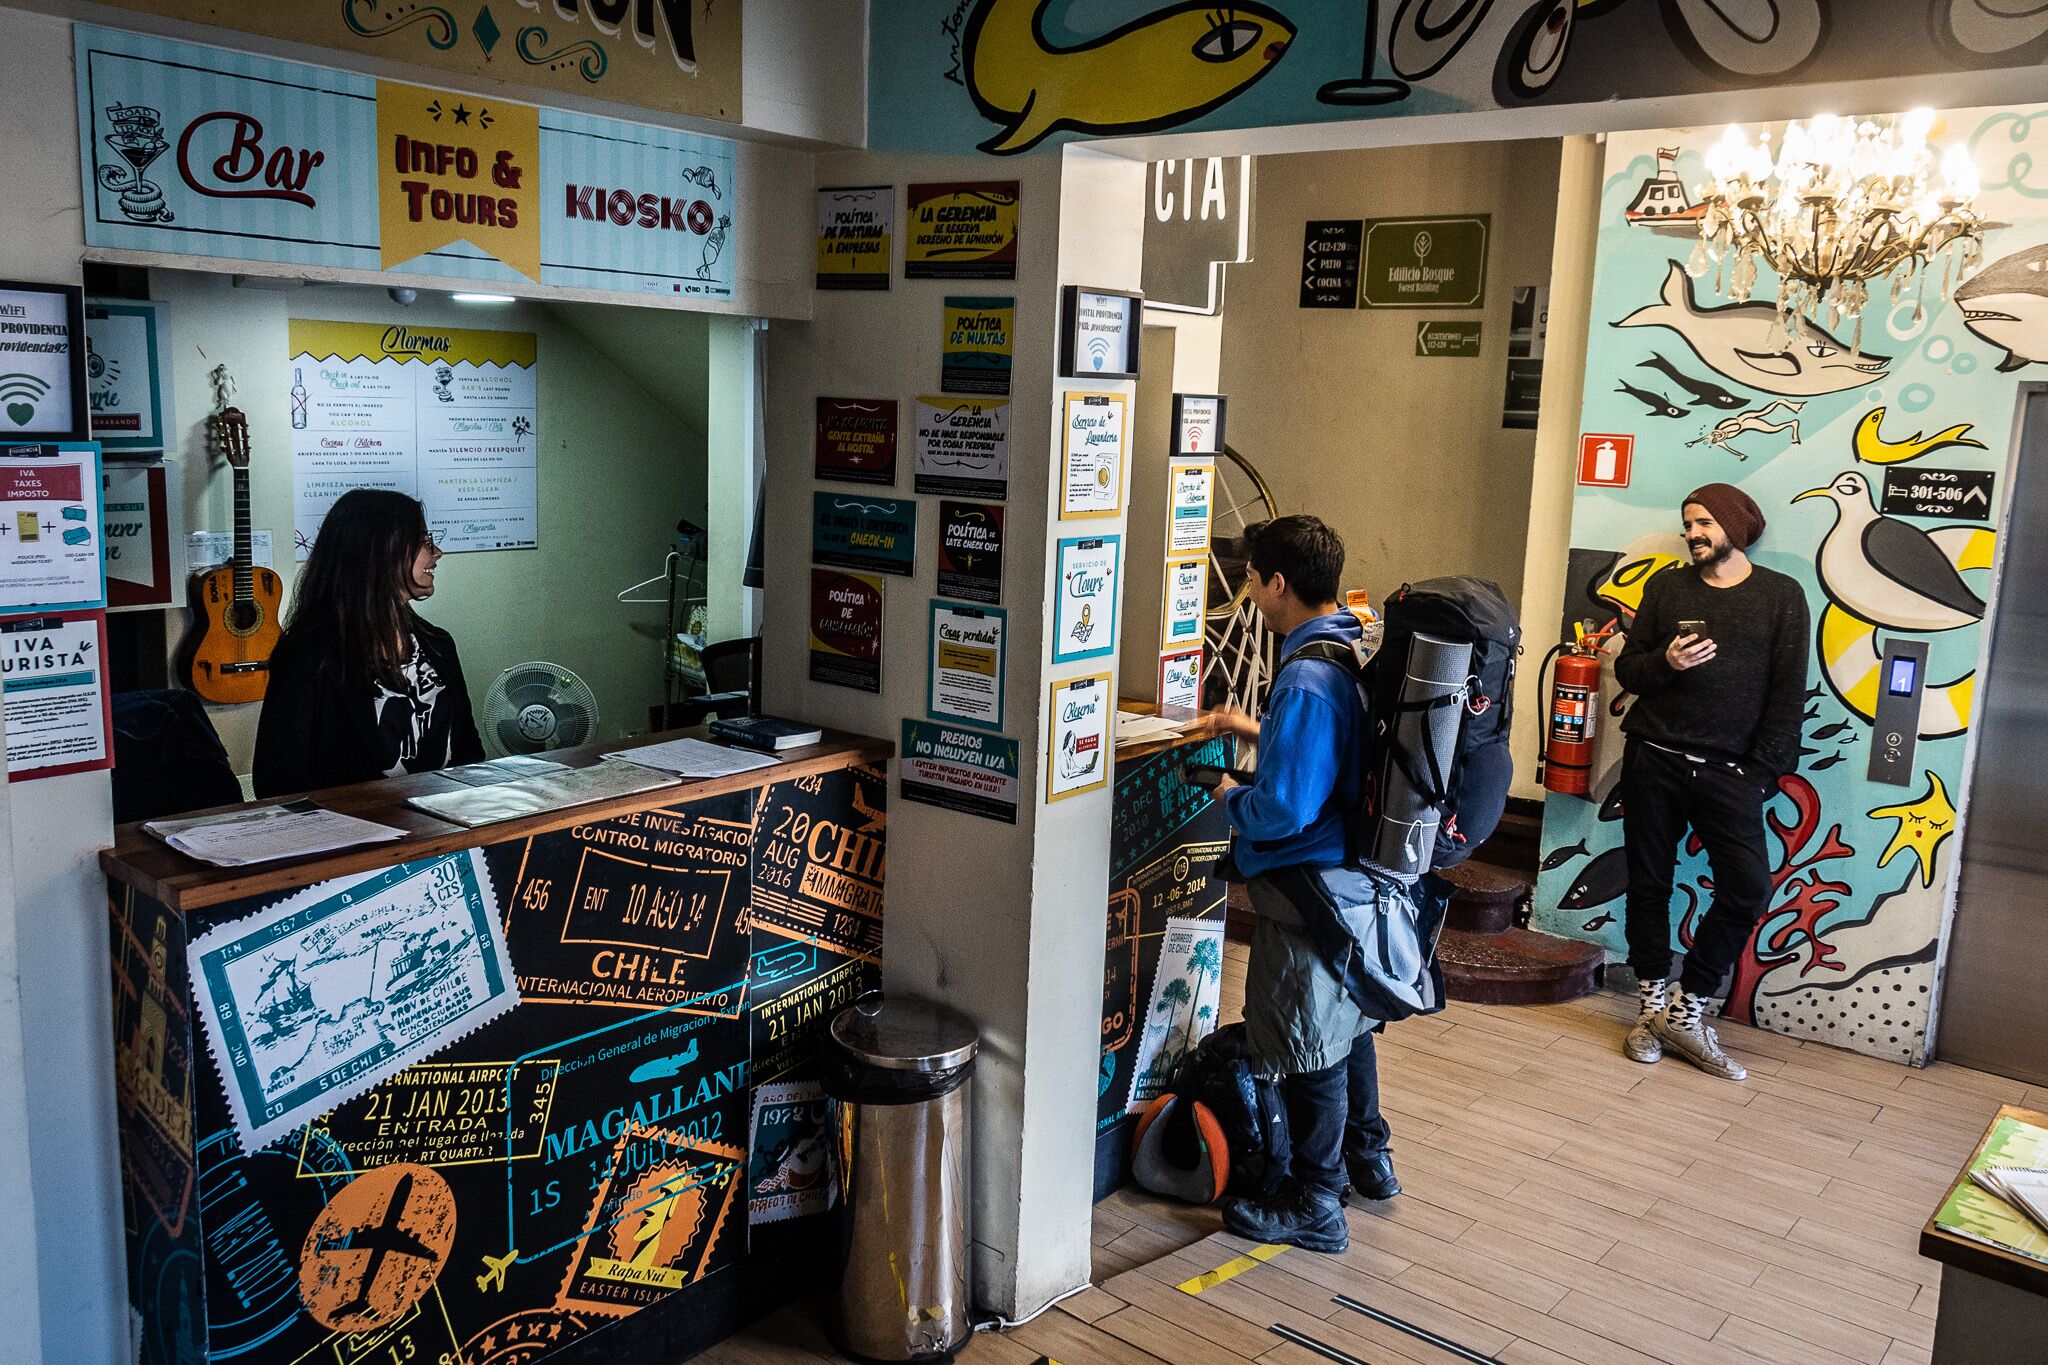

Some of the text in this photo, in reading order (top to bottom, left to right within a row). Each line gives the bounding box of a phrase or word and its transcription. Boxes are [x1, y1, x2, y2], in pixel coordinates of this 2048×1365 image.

[115, 108, 150, 119] ROAD
[177, 112, 324, 209] Bar
[492, 150, 523, 190] &
[401, 181, 519, 230] TOURS
[566, 183, 714, 236] KIOSKO
[920, 205, 997, 223] LA GERENCIA
[835, 208, 874, 224] POLÍTICA
[946, 223, 980, 233] RESERVA
[836, 242, 880, 255] EMPRESAS
[917, 235, 952, 245] DERECHO
[953, 235, 964, 245] DE
[1318, 242, 1347, 251] 112-120
[1320, 259, 1342, 269] PATIO
[1316, 277, 1342, 288] COCINA
[1388, 266, 1455, 283] Edificio Bosque
[1, 322, 68, 337] PROVIDENCIA
[956, 312, 1002, 331] POLÍTICA
[381, 326, 452, 355] Normas
[950, 331, 1007, 346] DE MULTAS
[972, 405, 982, 416] LA
[950, 416, 992, 429] GERENCIA
[827, 430, 851, 442] GENTE
[919, 429, 1005, 442] NO SE HACE RESPONSABLE
[927, 439, 995, 451] POR COSAS PERDIDAS
[837, 442, 847, 452] AL
[20, 469, 36, 478] IVA
[14, 480, 42, 488] TAXES
[1909, 485, 1963, 501] 301-506
[7, 490, 50, 498] IMPOSTO
[947, 521, 988, 539] POLÍTICA
[850, 531, 896, 550] CHECK-IN
[945, 538, 1000, 553] LATE CHECK OUT
[1072, 560, 1099, 570] SERVICIO
[1069, 570, 1104, 598] Tours
[829, 588, 865, 606] POLÍTICA
[841, 608, 853, 619] DE
[939, 623, 997, 646] Cosas perdidas
[14, 636, 54, 653] IVA
[1, 652, 86, 673] URISTA
[940, 729, 983, 750] PRECIOS
[916, 740, 932, 754] NO
[934, 744, 982, 766] INCLUYEN
[918, 769, 983, 788] TURISTAS PAGANDO EN
[938, 763, 1008, 787] IMPUESTOS SOLAMENTE
[793, 774, 824, 796] 1234
[772, 806, 811, 845] 20
[571, 825, 749, 868] CONTROL MIGRATORIO
[762, 839, 801, 869] AUG
[430, 861, 456, 888] 30
[522, 878, 552, 912] 456
[1152, 892, 1164, 909] 12
[1186, 876, 1207, 896] 2014
[583, 882, 645, 926] ENT 10
[1170, 932, 1193, 943] CORREOS
[1167, 943, 1190, 954] DE CHILE
[591, 949, 689, 987] CHILE
[391, 972, 468, 1021] PROV DE CHILOE
[761, 978, 830, 1020] INTERNATIONAL
[397, 985, 471, 1029] HOMENAJE A SUS
[400, 992, 473, 1037] CINCO CIUDADES
[768, 1014, 788, 1041] 21
[794, 995, 823, 1028] JAN
[828, 976, 864, 1011] 2013
[409, 1003, 469, 1040] CENTENARIAS
[1101, 1011, 1124, 1035] GO
[597, 1036, 642, 1062] General
[643, 1028, 658, 1045] de
[331, 1068, 349, 1084] DE
[363, 1087, 508, 1122] 21 JAN 2013
[528, 1082, 552, 1125] 345
[762, 1094, 783, 1103] AÑO
[377, 1117, 488, 1136] ENTRADA
[676, 1111, 723, 1154] 2012
[462, 1130, 476, 1143] de
[607, 1263, 668, 1282] Rapa Nui
[579, 1281, 628, 1299] EASTER
